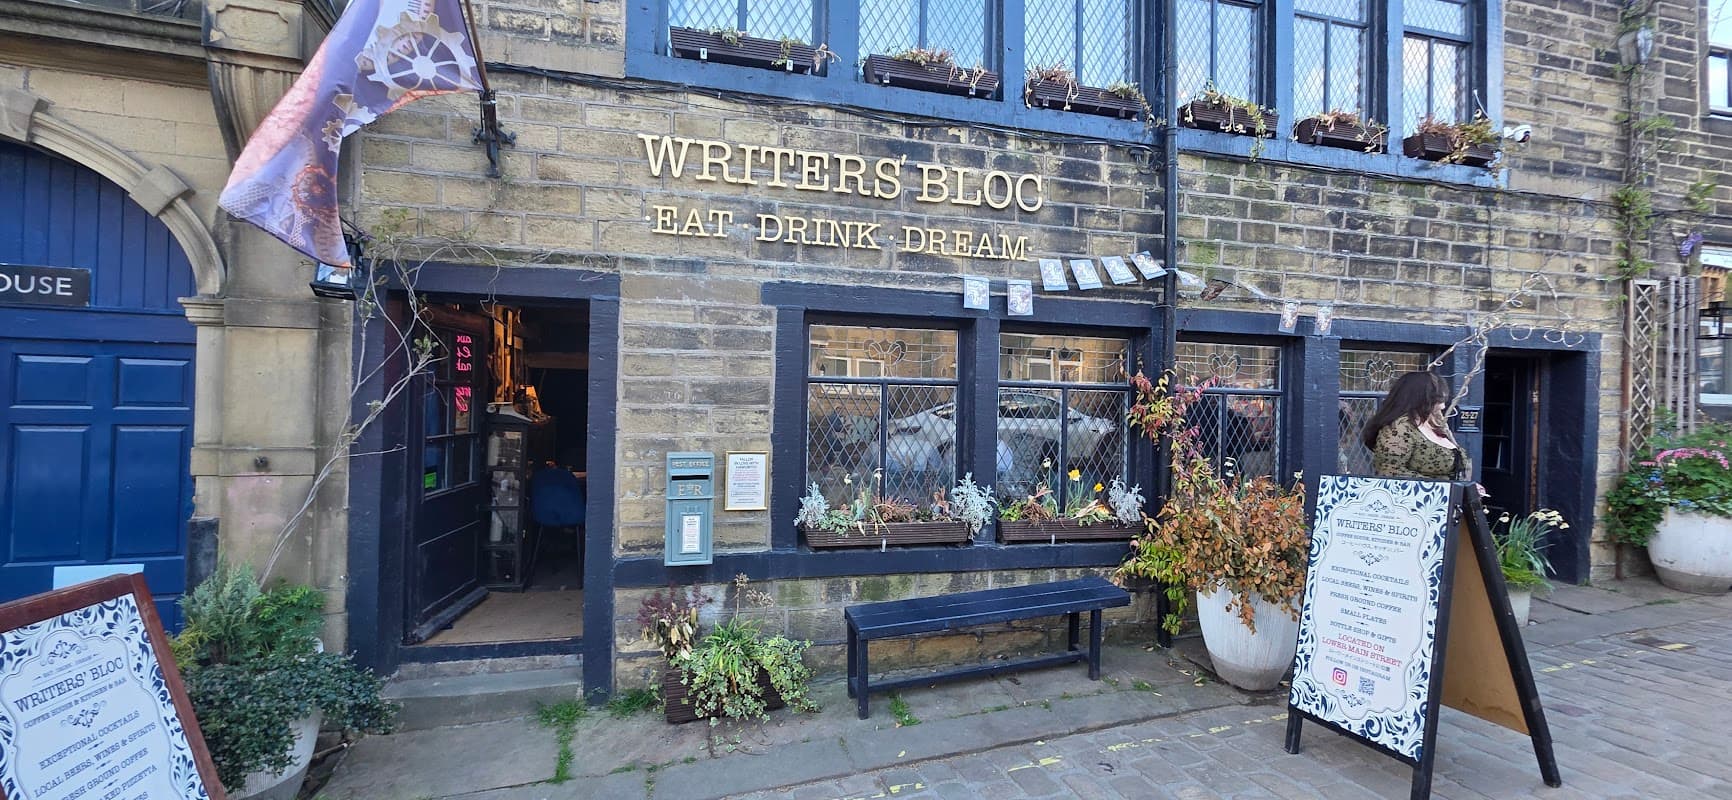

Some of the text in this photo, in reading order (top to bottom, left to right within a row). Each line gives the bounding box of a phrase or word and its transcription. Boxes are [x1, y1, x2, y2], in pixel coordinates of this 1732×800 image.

[637, 133, 1044, 212] WRITERS' BLOC
[756, 213, 881, 250] DRINK
[1336, 518, 1418, 538] WRITERS' BLOC
[1321, 576, 1340, 585] LOCAL
[1363, 585, 1384, 595] WINES
[1331, 565, 1409, 586] EXCEPTIONAL COCKTAILS
[1329, 591, 1402, 613] FRESH GROUND COFFEE
[1340, 608, 1388, 625] SMALL PLATES
[1330, 620, 1353, 631] BOTTLE
[1353, 627, 1370, 636] SHOP
[1376, 633, 1397, 644] GIFTS
[1338, 633, 1385, 653] LOCATED ON
[1321, 636, 1348, 650] LOWER
[1347, 644, 1369, 657] MAIN
[1370, 652, 1402, 668] STREET
[13, 671, 87, 712] WRITERS'
[90, 657, 124, 681] BLOC
[39, 710, 140, 771] EXCEPTIONAL COCKTAILS
[34, 775, 65, 798] LOCAL
[94, 743, 121, 761] WINES
[121, 738, 128, 746] &
[128, 722, 156, 742] SPIRITS
[87, 765, 120, 790] GROUND
[120, 747, 149, 769] COFFEE
